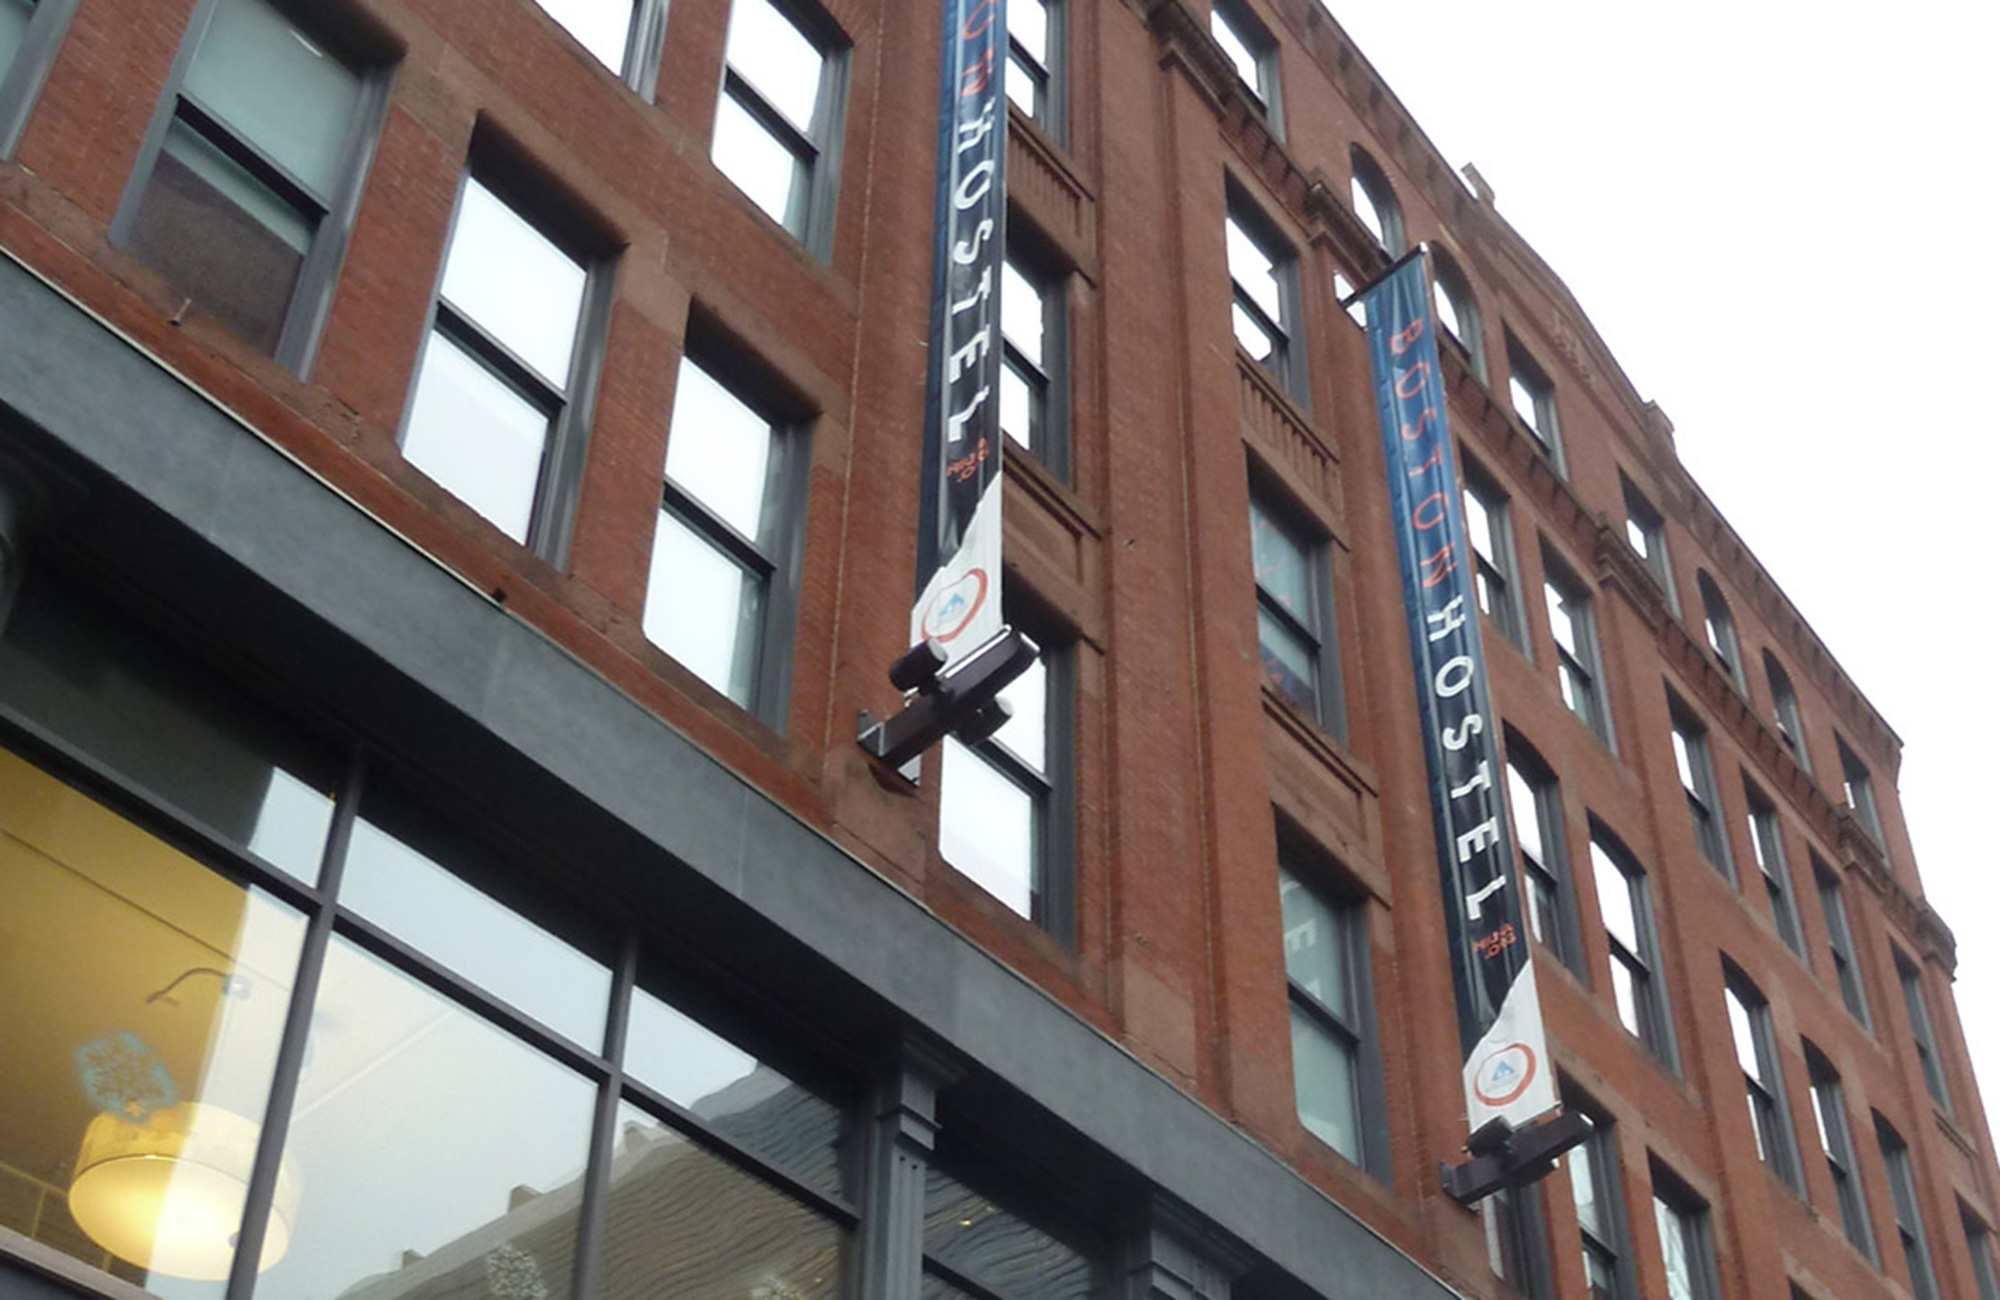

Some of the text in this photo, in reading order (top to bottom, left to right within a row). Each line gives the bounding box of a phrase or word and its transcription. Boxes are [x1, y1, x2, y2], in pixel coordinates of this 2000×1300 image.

[949, 97, 994, 442] HOSTEL
[1390, 318, 1507, 920] BOSTON HOSTEL
